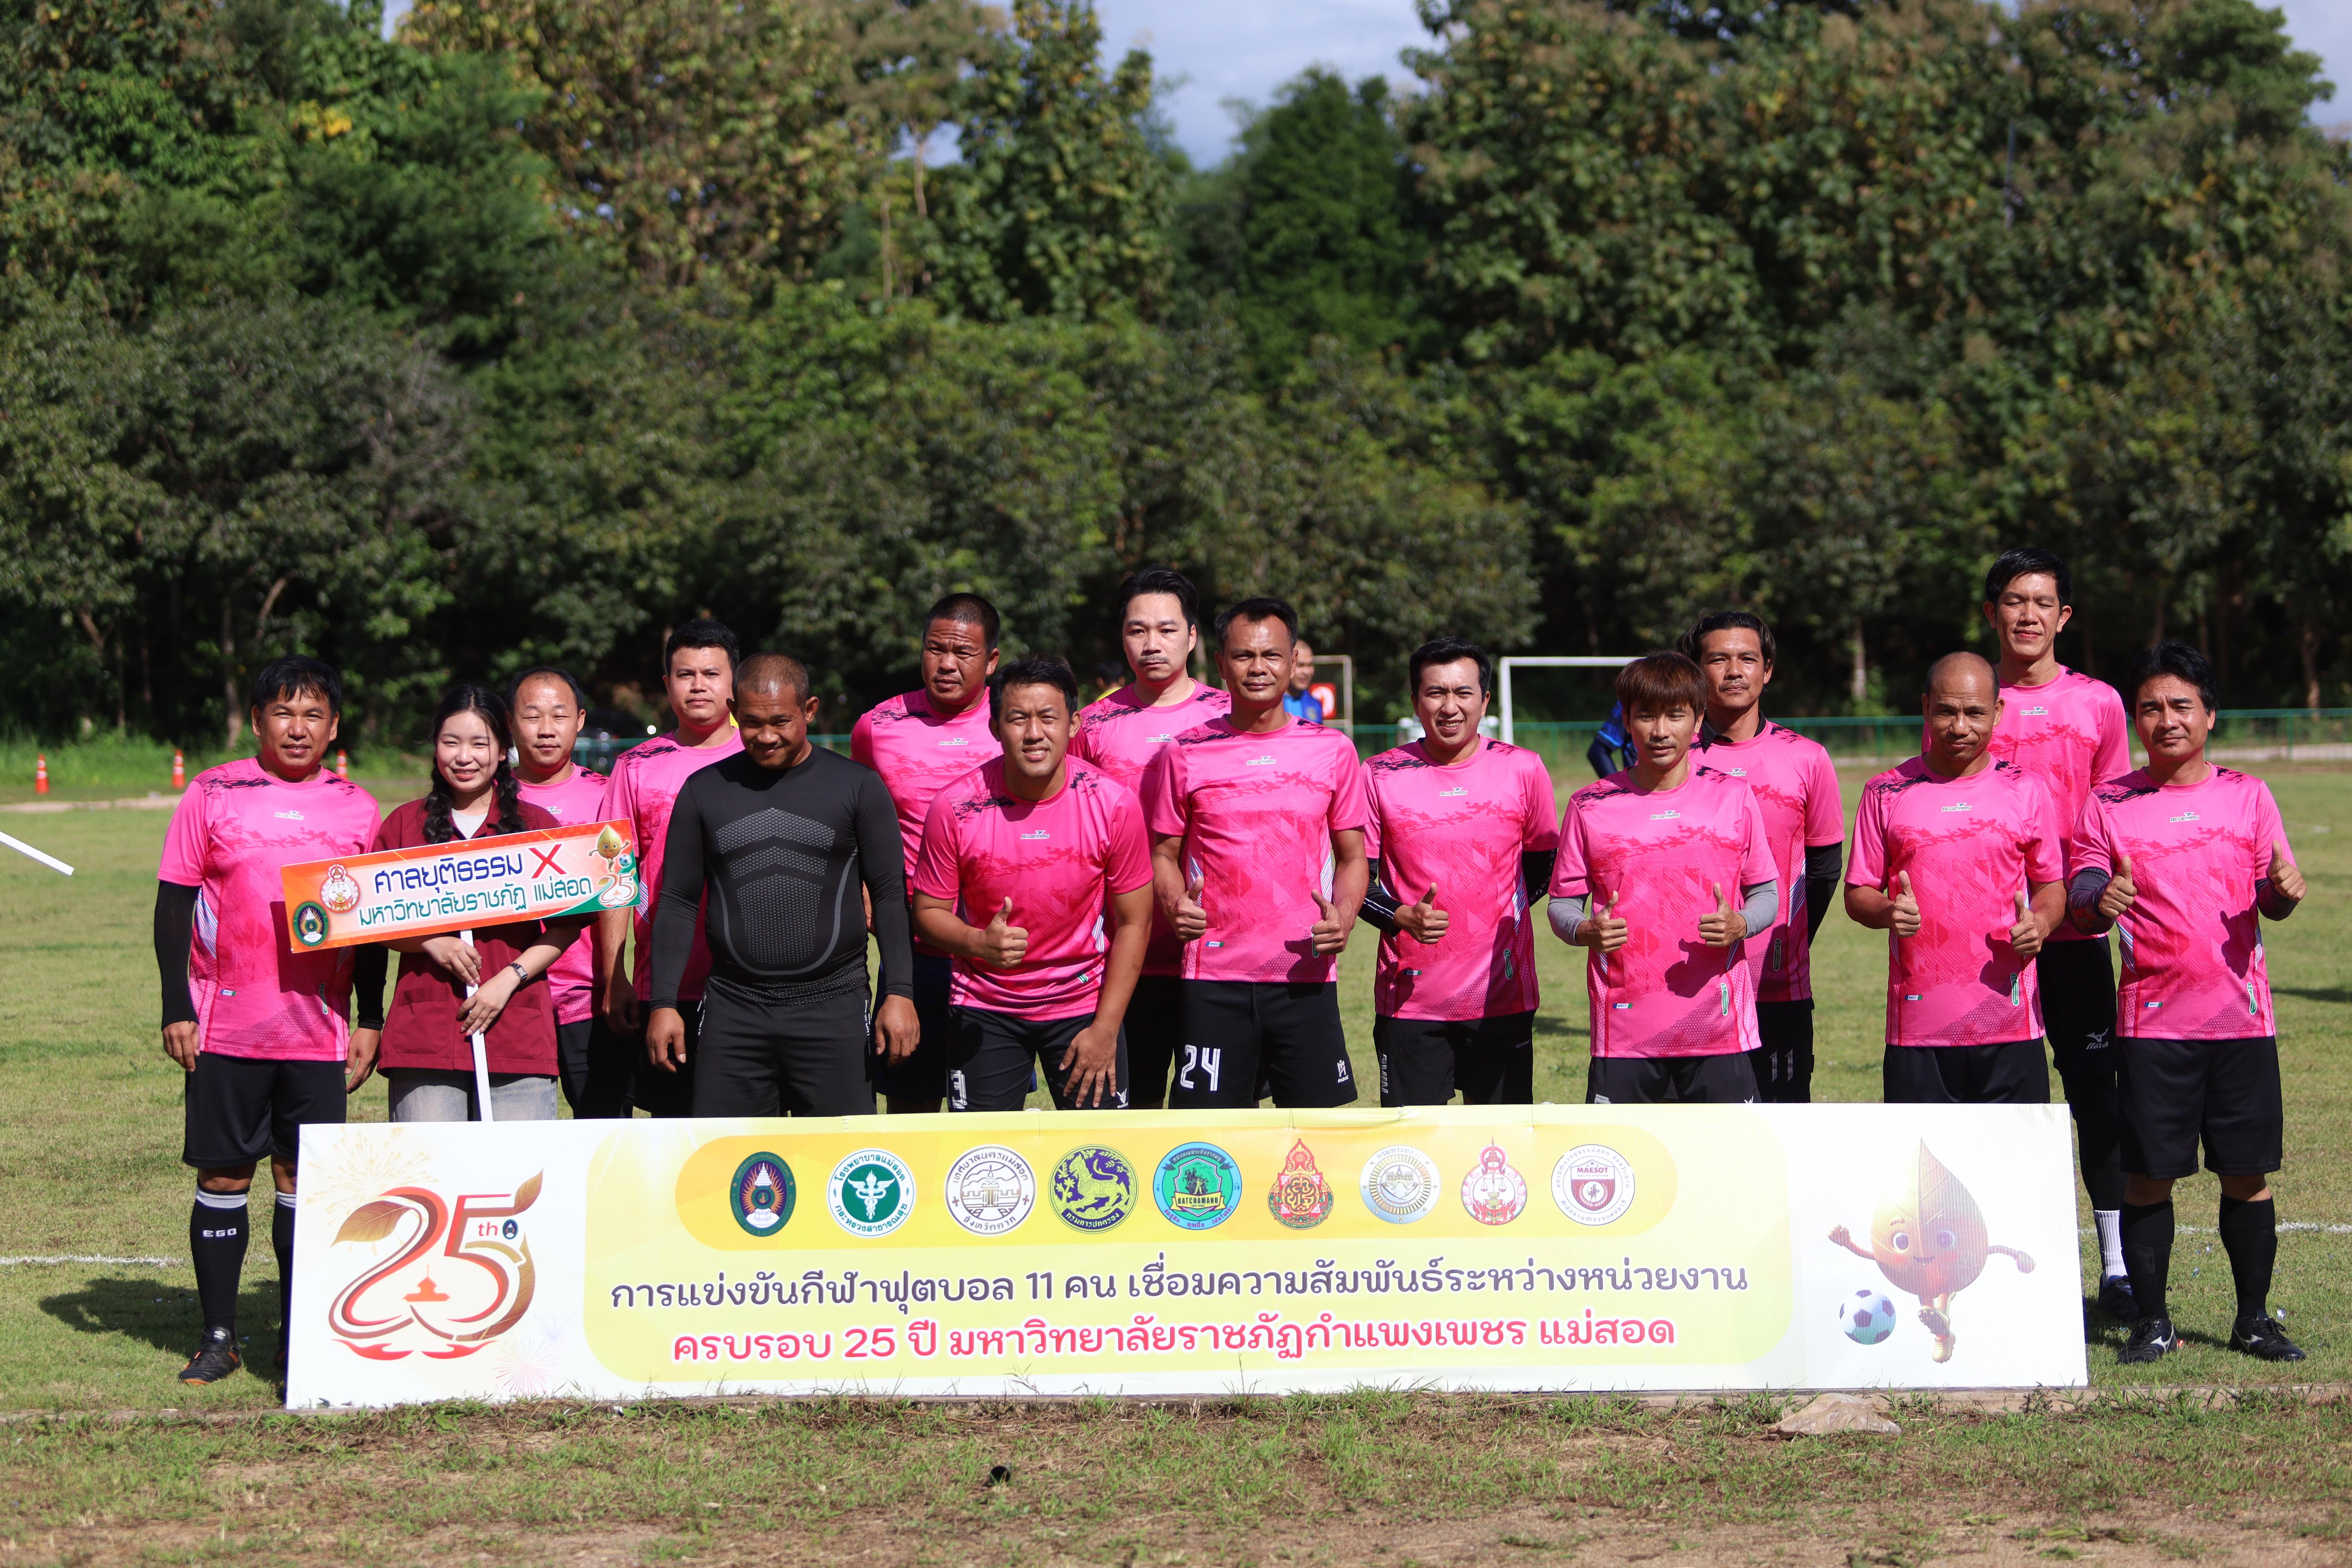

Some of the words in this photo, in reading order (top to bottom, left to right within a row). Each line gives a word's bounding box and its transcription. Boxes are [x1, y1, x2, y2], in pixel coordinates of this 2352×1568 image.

[374, 853, 523, 894] ศาลยุติธรรม
[530, 844, 567, 879] X
[359, 882, 527, 927] มหาวิทยาลัยราชภัฏ
[534, 876, 593, 902] แม่สอด
[598, 871, 638, 905] 25
[1180, 1044, 1221, 1091] 24
[1769, 1049, 1793, 1082] 11
[834, 1154, 906, 1182] โรงพยาบาลแม่สอด
[952, 1152, 1029, 1183] เทศบาลนครแม่สอด
[1376, 1147, 1422, 1159] กรมทางหลวง
[203, 1228, 237, 1237] EGO
[835, 1203, 908, 1232] กระทรวงสาธารณสุข
[963, 1215, 1017, 1231] จังหวัดตาก
[1066, 1212, 1120, 1228] กรมการปกครอง
[329, 1180, 539, 1342] 25
[478, 1222, 499, 1237] th
[611, 1269, 1014, 1315] การแข่งขันกีฬาฟุตบอล
[1025, 1271, 1052, 1300] 11
[1065, 1275, 1117, 1299] คน
[1129, 1251, 1748, 1297] เชื่อมความสัมพันธ์ระหว่างหน่วยงาน
[674, 1333, 831, 1360] ครบรอบ
[844, 1328, 896, 1358] 25
[908, 1320, 936, 1356] ปี
[950, 1313, 1527, 1359] มหาวิทยาลัยราชภัฏกำแพงเพชร
[1540, 1309, 1675, 1344] แม่สอด
